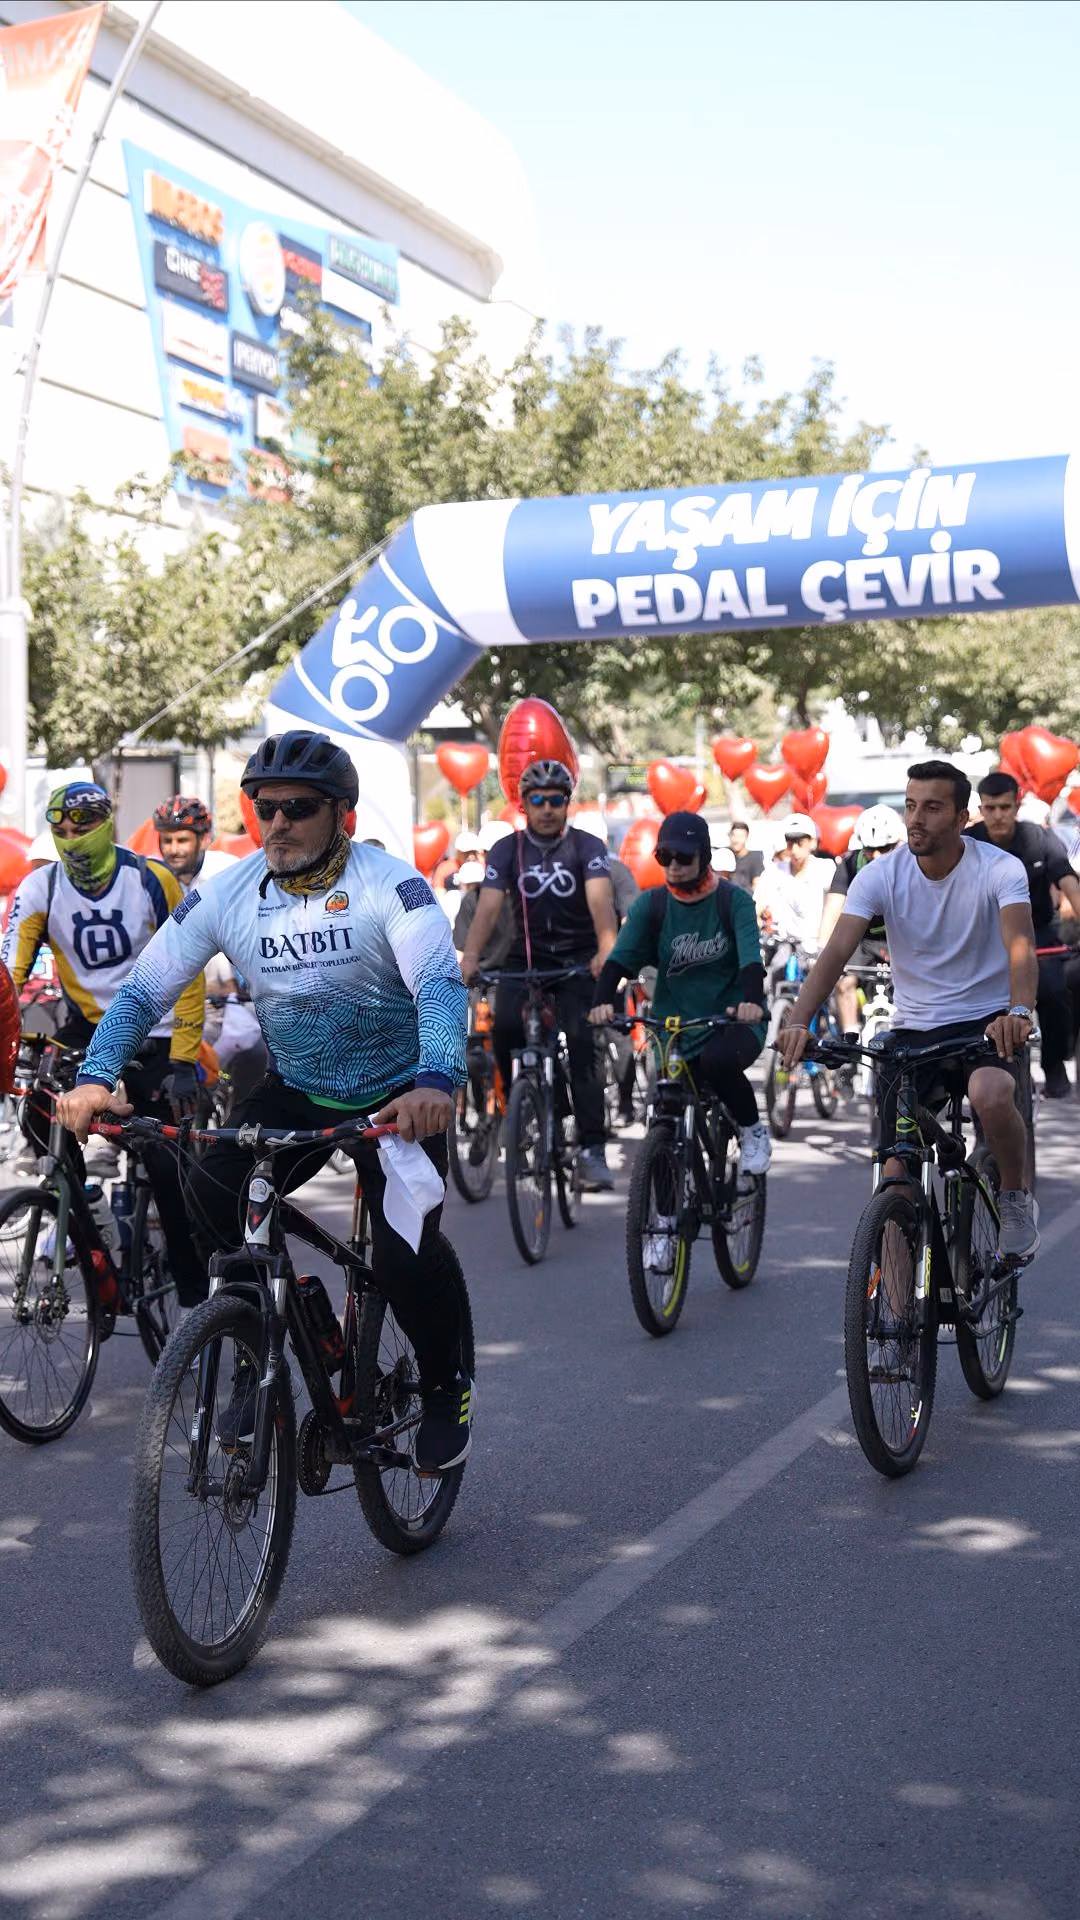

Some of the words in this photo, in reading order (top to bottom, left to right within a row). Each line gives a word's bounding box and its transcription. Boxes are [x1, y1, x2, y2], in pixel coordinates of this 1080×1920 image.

[589, 487, 819, 570] YAŞAM
[828, 469, 976, 556] İÇİN
[572, 567, 787, 629] PEDAL
[800, 531, 1004, 622] ÇEVİR
[258, 924, 353, 961] BATBİT
[261, 964, 291, 973] BATMAN
